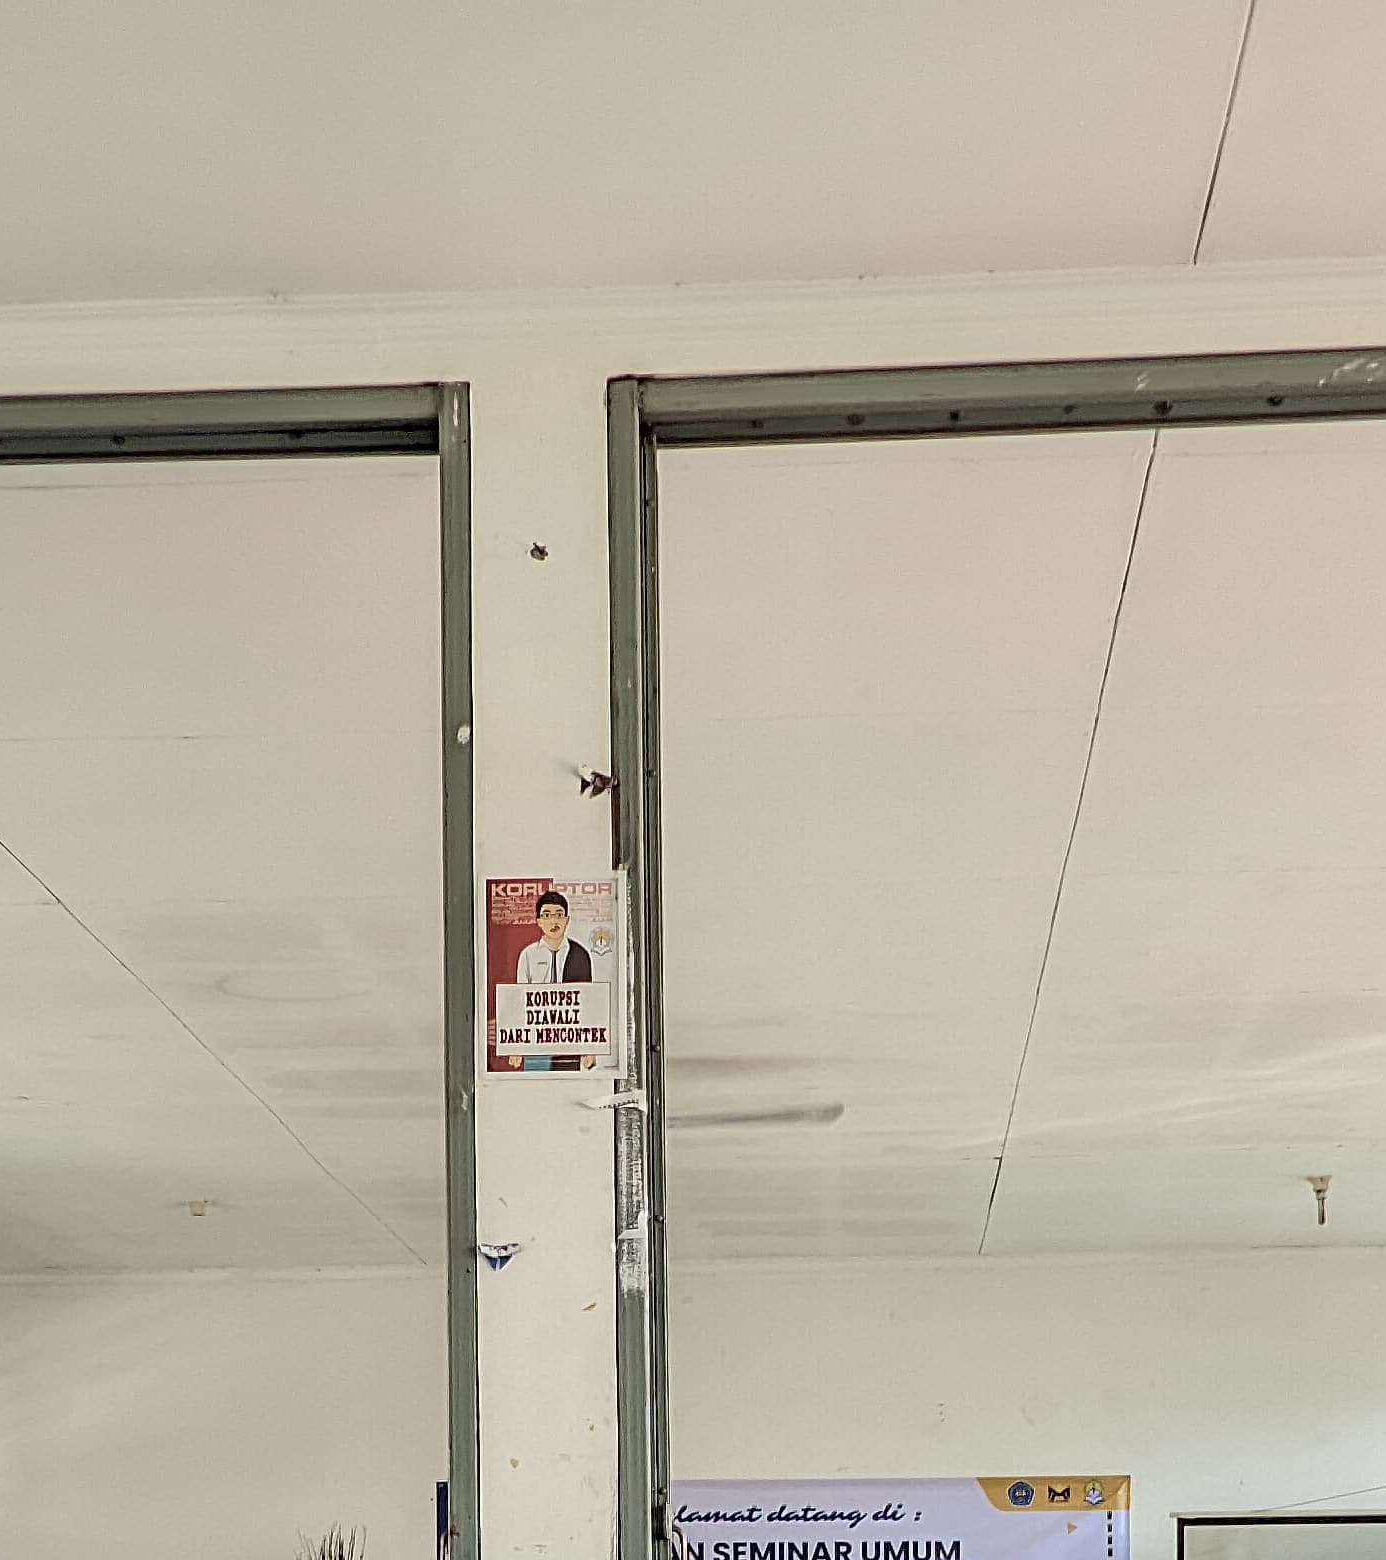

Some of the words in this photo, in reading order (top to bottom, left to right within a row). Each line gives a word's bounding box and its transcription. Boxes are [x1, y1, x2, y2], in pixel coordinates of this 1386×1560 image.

[491, 882, 612, 897] KORUPTOR
[525, 990, 580, 1007] KORUPSI
[526, 1008, 580, 1025] DIAWALI
[500, 1028, 531, 1043] DARI
[536, 1027, 607, 1043] MENCONTEK
[674, 1504, 762, 1523] lamat
[766, 1504, 866, 1528] datang
[872, 1503, 906, 1522] di
